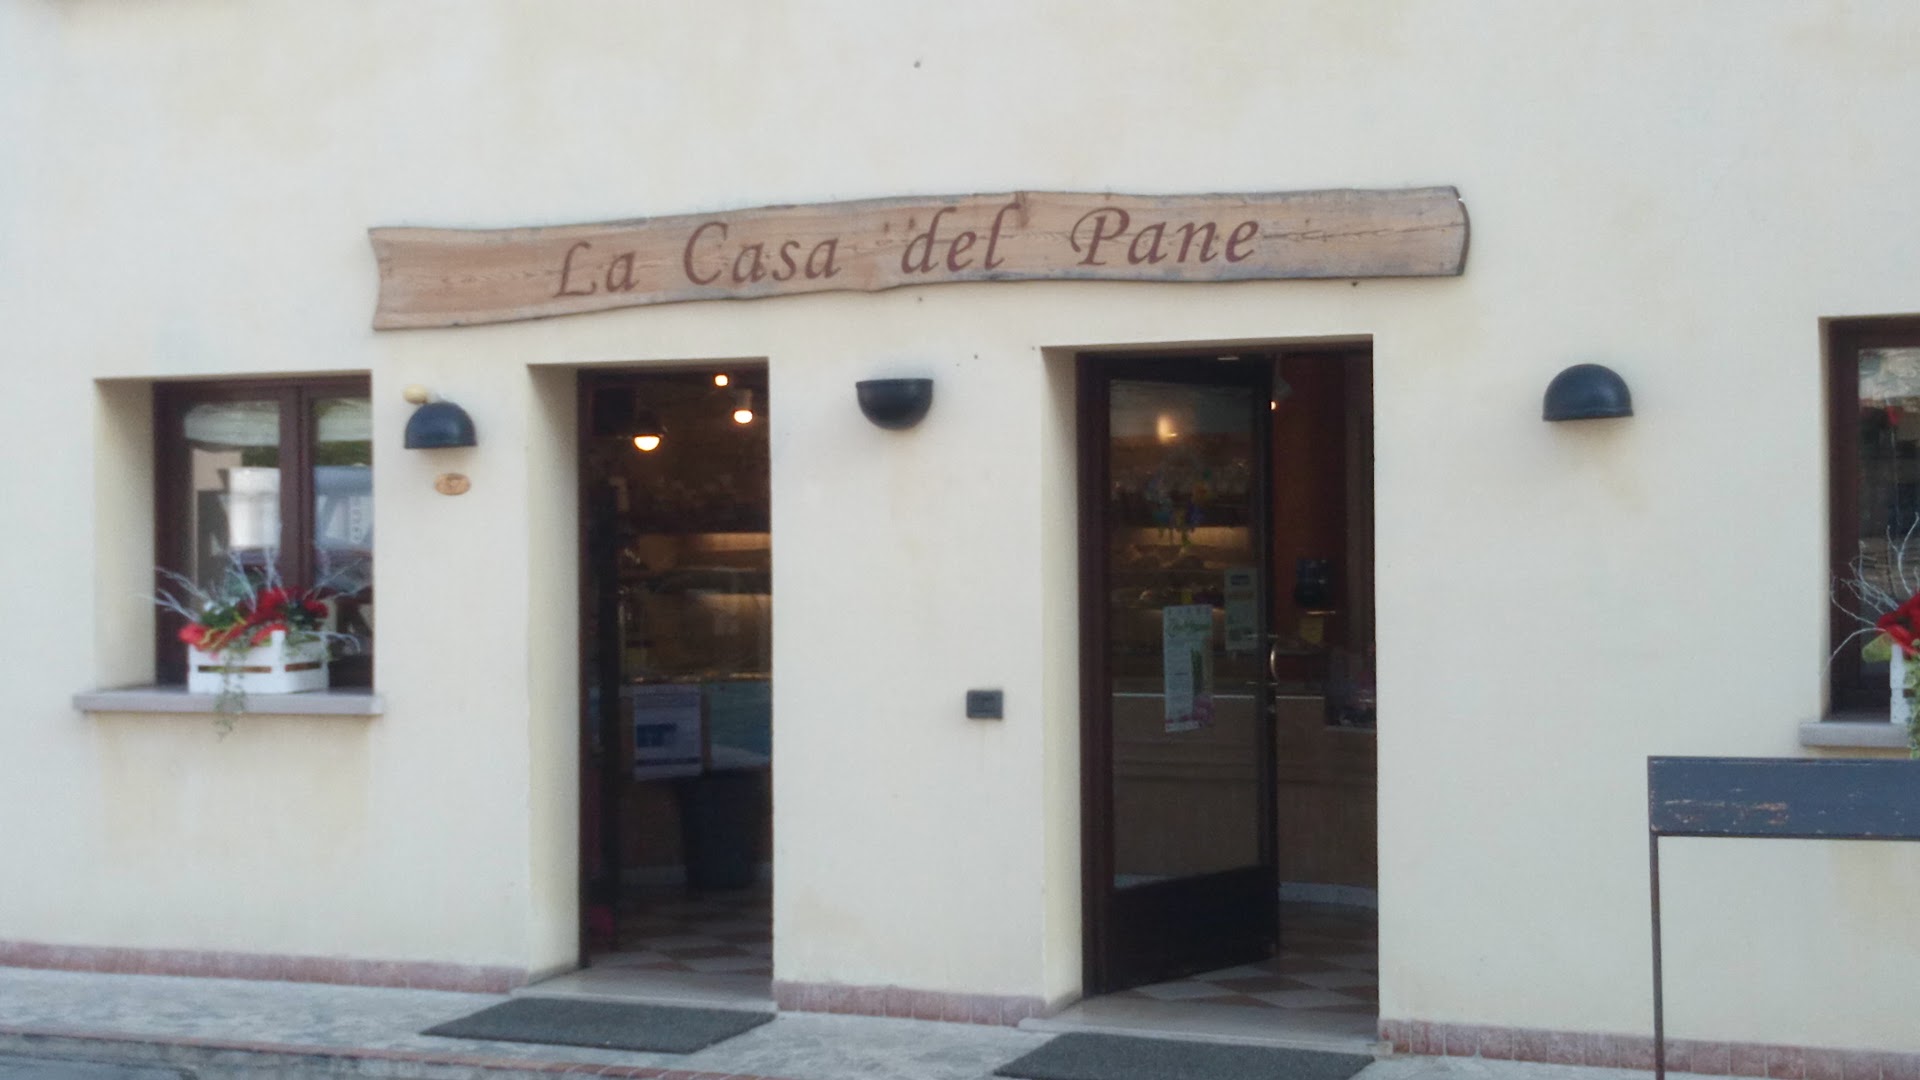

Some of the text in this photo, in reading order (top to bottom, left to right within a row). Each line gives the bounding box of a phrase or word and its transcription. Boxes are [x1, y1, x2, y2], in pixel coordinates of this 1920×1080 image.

[553, 206, 1260, 298] La Casa del Pane
